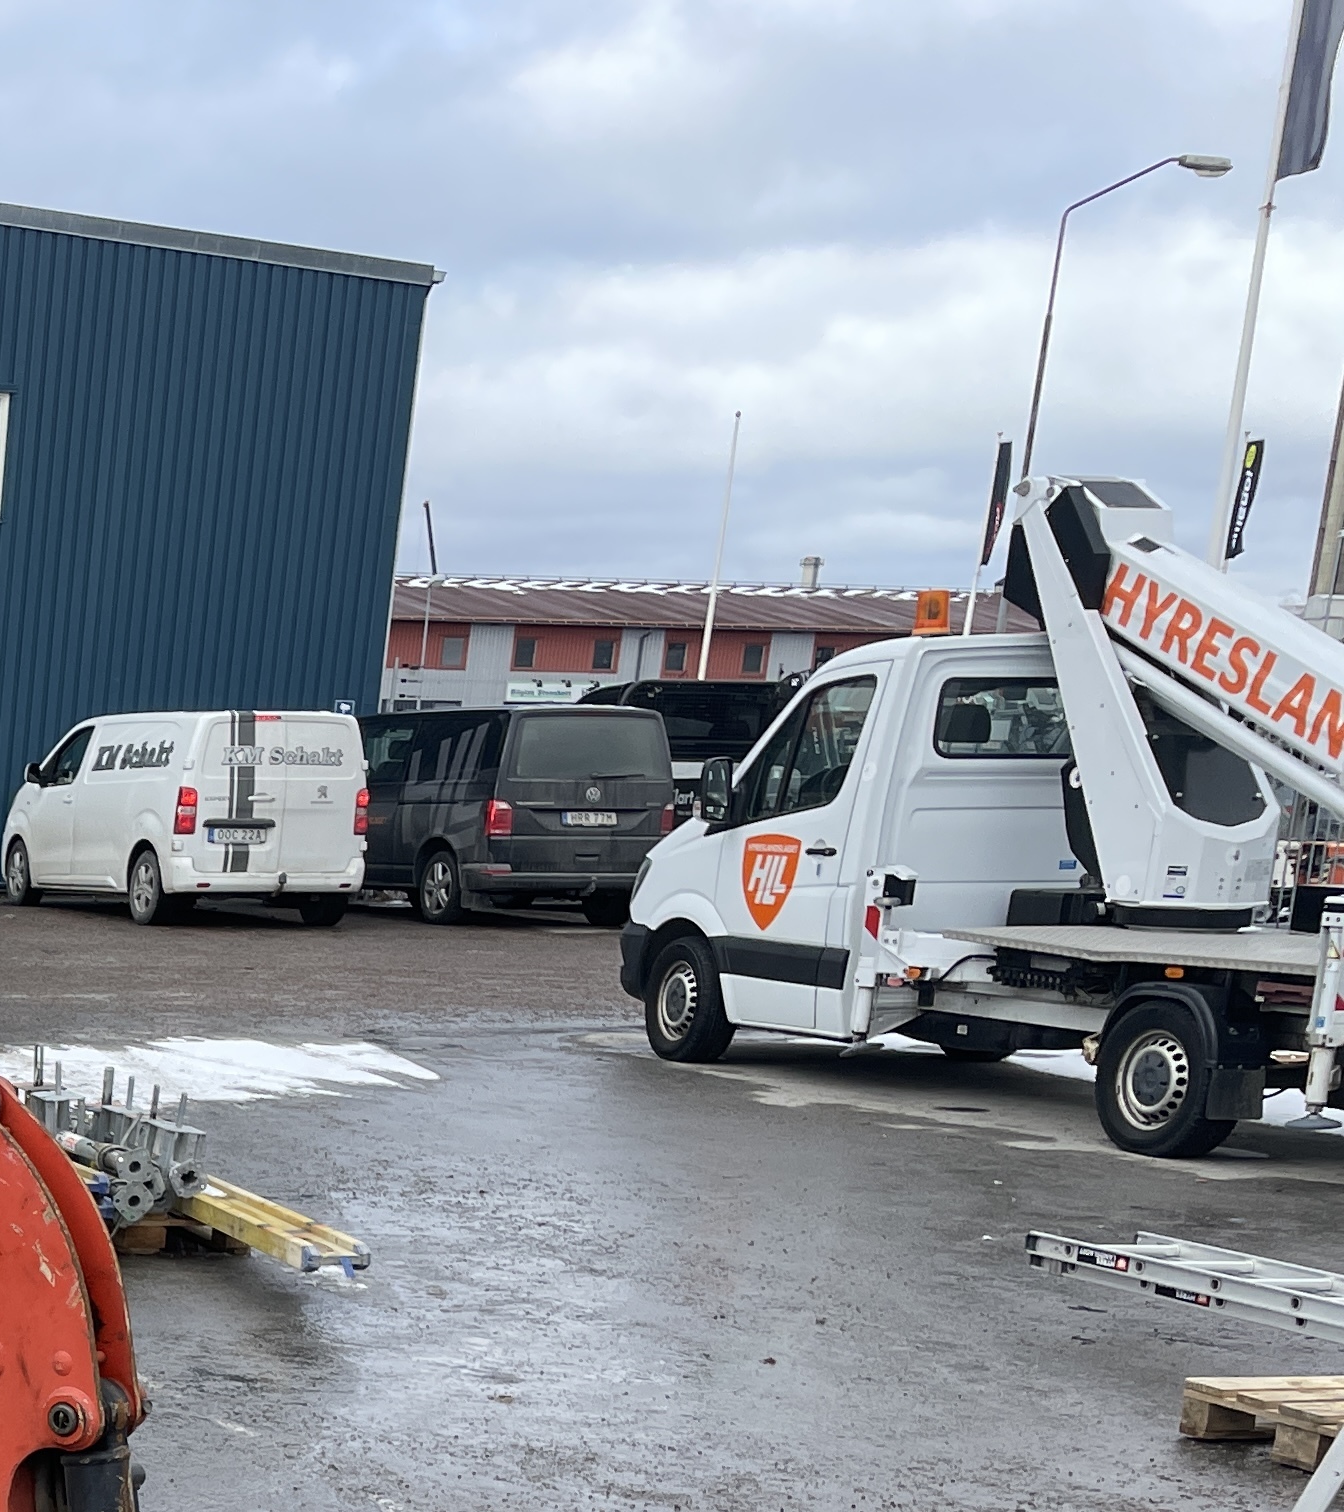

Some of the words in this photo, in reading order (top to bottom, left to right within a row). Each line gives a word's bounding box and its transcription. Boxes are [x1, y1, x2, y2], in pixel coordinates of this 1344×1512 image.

[1100, 563, 1344, 761] HYRESLAN
[221, 746, 265, 767] KM
[268, 746, 345, 767] Schakt
[241, 829, 262, 841] 22A
